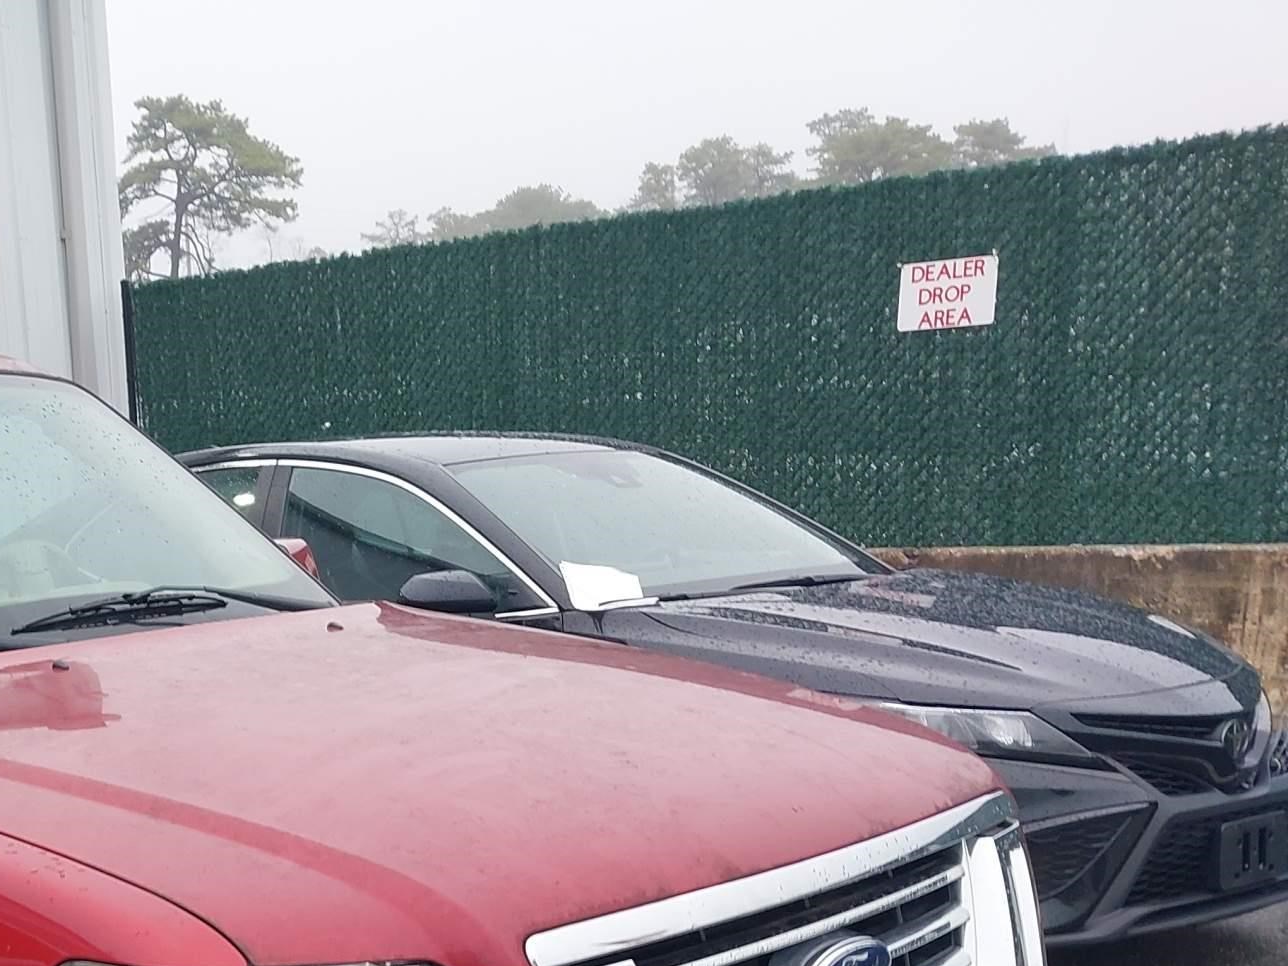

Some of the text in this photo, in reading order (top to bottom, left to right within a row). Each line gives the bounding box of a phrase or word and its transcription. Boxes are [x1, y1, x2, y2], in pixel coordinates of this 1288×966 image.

[911, 259, 985, 283] DEALER
[918, 284, 971, 305] DROP
[918, 307, 972, 329] AREA
